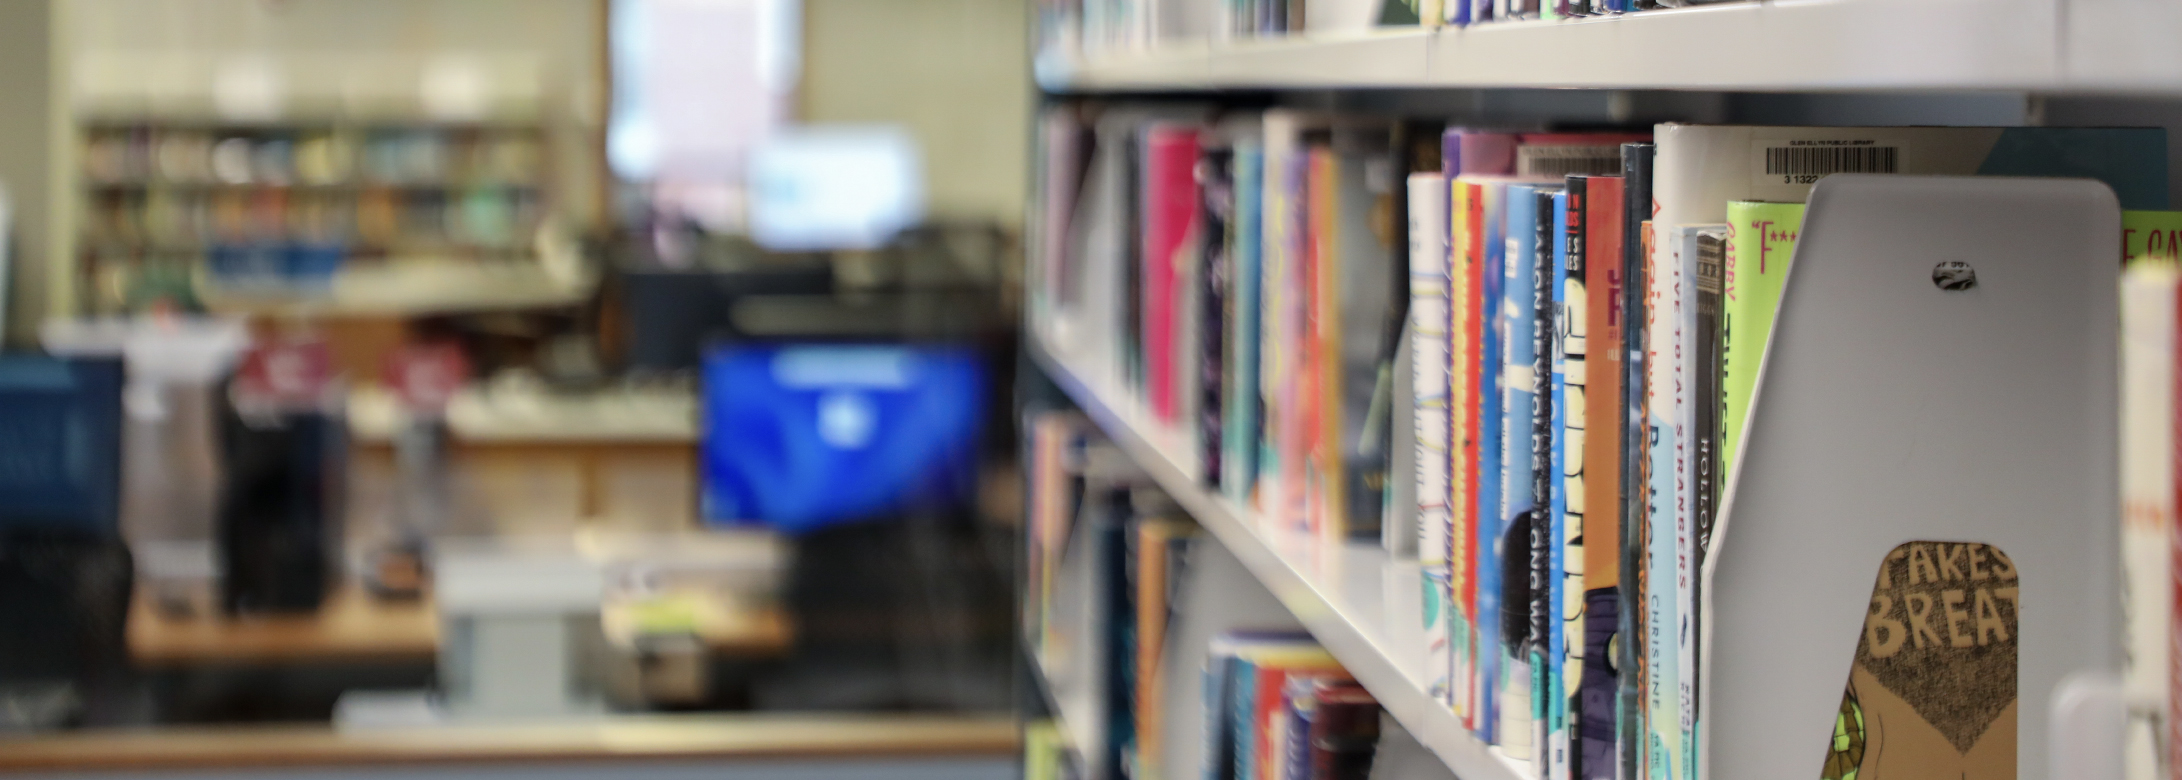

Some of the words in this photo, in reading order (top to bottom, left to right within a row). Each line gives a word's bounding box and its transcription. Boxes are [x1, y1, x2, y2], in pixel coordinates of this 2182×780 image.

[1784, 175, 1790, 184] 3
[1673, 252, 1681, 314] FIVE
[1674, 326, 1682, 411] TOTAL
[1676, 422, 1686, 590] STRANGERS
[1700, 436, 1710, 550] HOLLOW
[1878, 542, 2018, 590] TAKES
[1651, 594, 1660, 710] CHRISTINE
